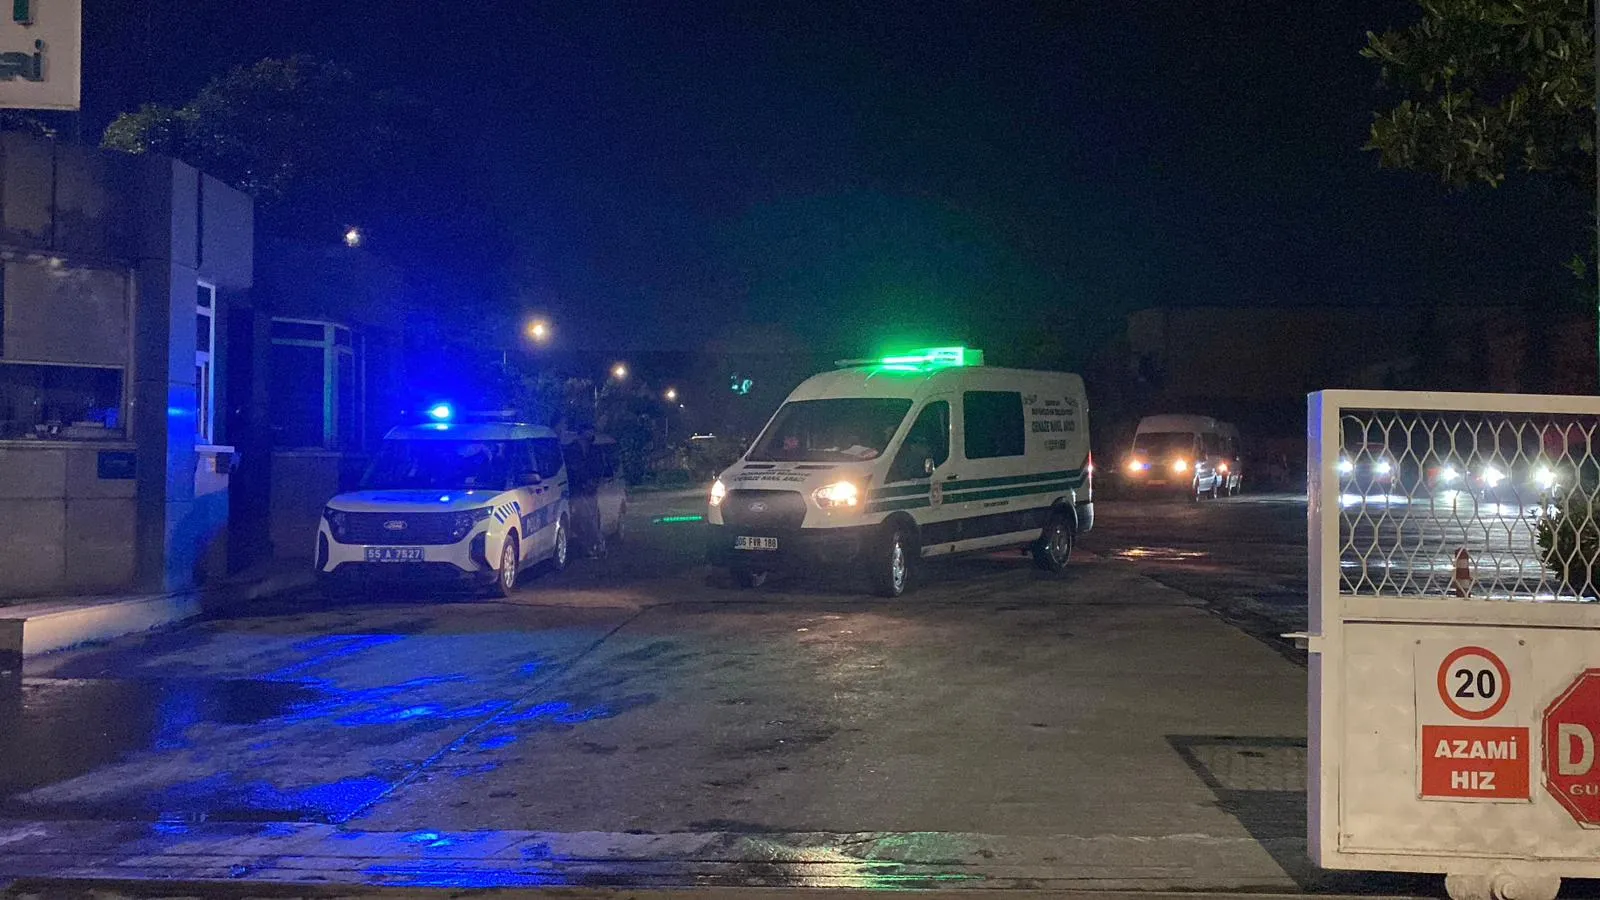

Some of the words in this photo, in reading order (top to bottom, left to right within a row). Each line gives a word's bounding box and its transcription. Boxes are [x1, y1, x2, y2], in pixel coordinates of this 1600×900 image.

[368, 549, 381, 558] 55
[385, 549, 392, 558] A
[396, 549, 420, 559] 7527
[1454, 668, 1496, 699] 20
[1434, 736, 1517, 760] AZAMİ
[1451, 770, 1496, 790] HIZ
